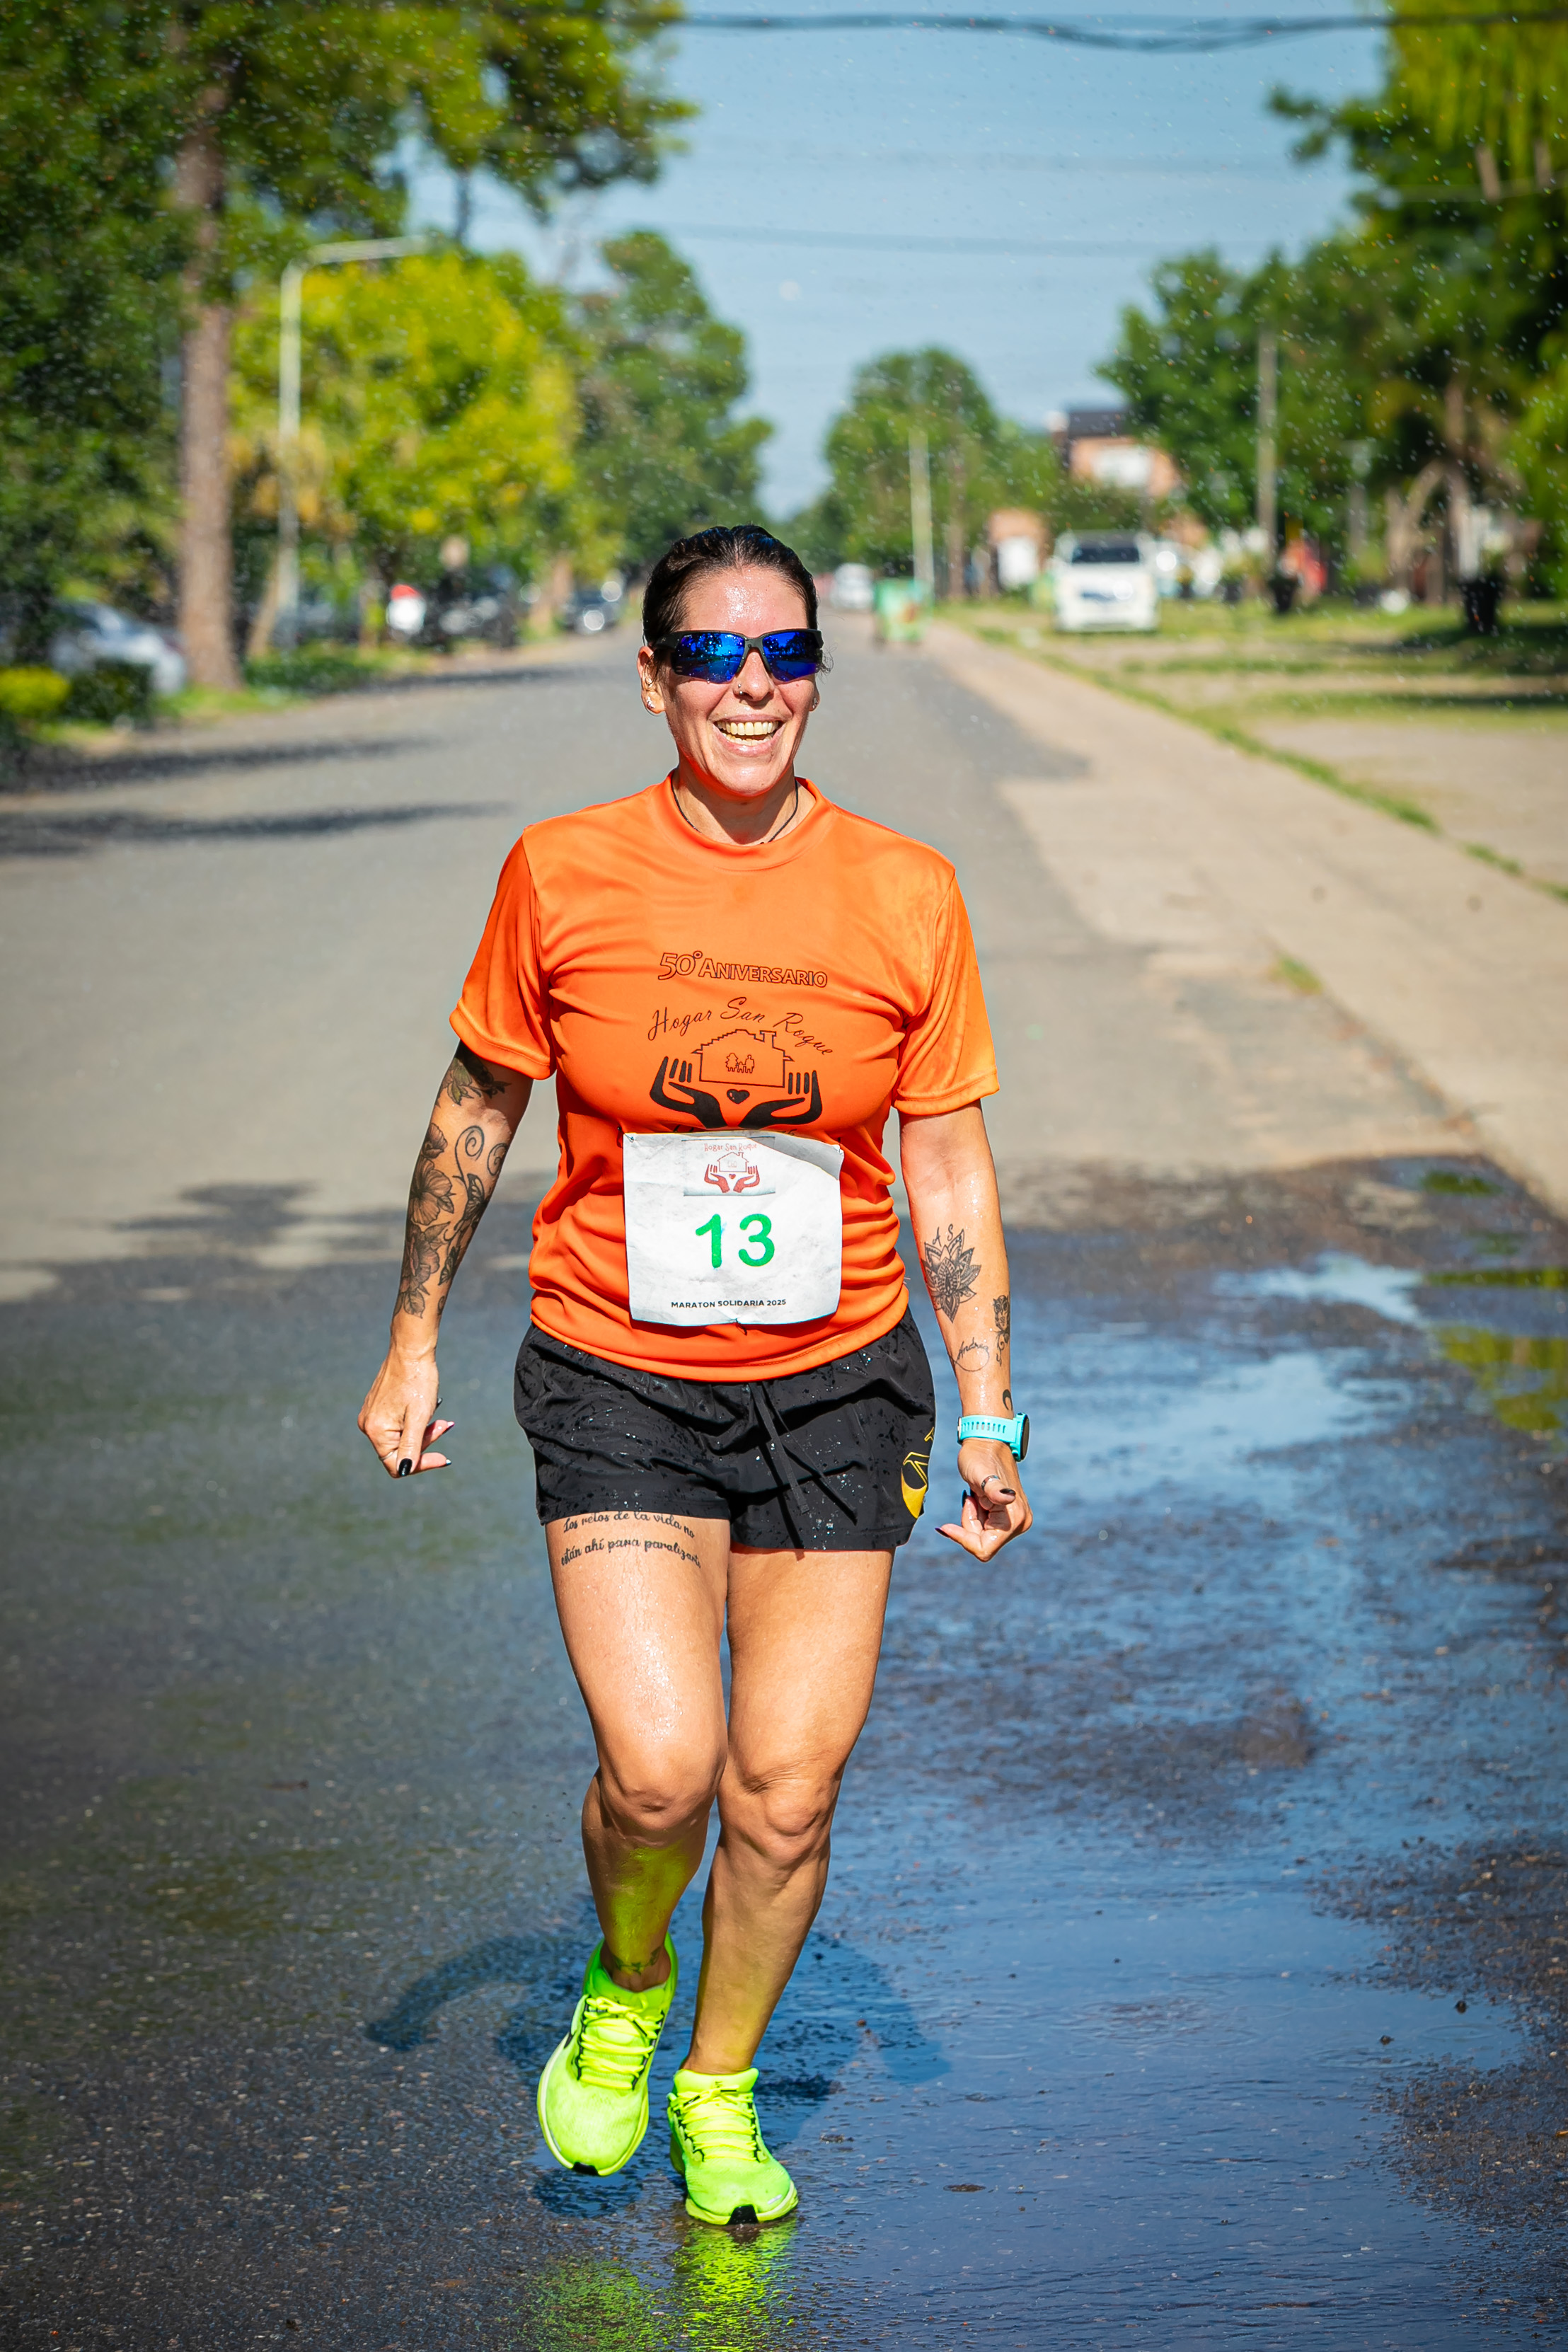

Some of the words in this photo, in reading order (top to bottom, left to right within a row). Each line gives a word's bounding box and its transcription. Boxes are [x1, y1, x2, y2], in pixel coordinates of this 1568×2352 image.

[698, 957, 828, 988] ANIVERSARIO
[647, 1006, 712, 1041] Hogar
[720, 997, 765, 1022] San
[772, 1013, 833, 1055] Roque
[704, 1143, 723, 1152] Hogar
[725, 1143, 737, 1152] San
[738, 1143, 757, 1151] Roque
[695, 1214, 776, 1269] 13
[653, 1514, 682, 1530] vida
[684, 1526, 695, 1538] no
[585, 1538, 604, 1554] ahí
